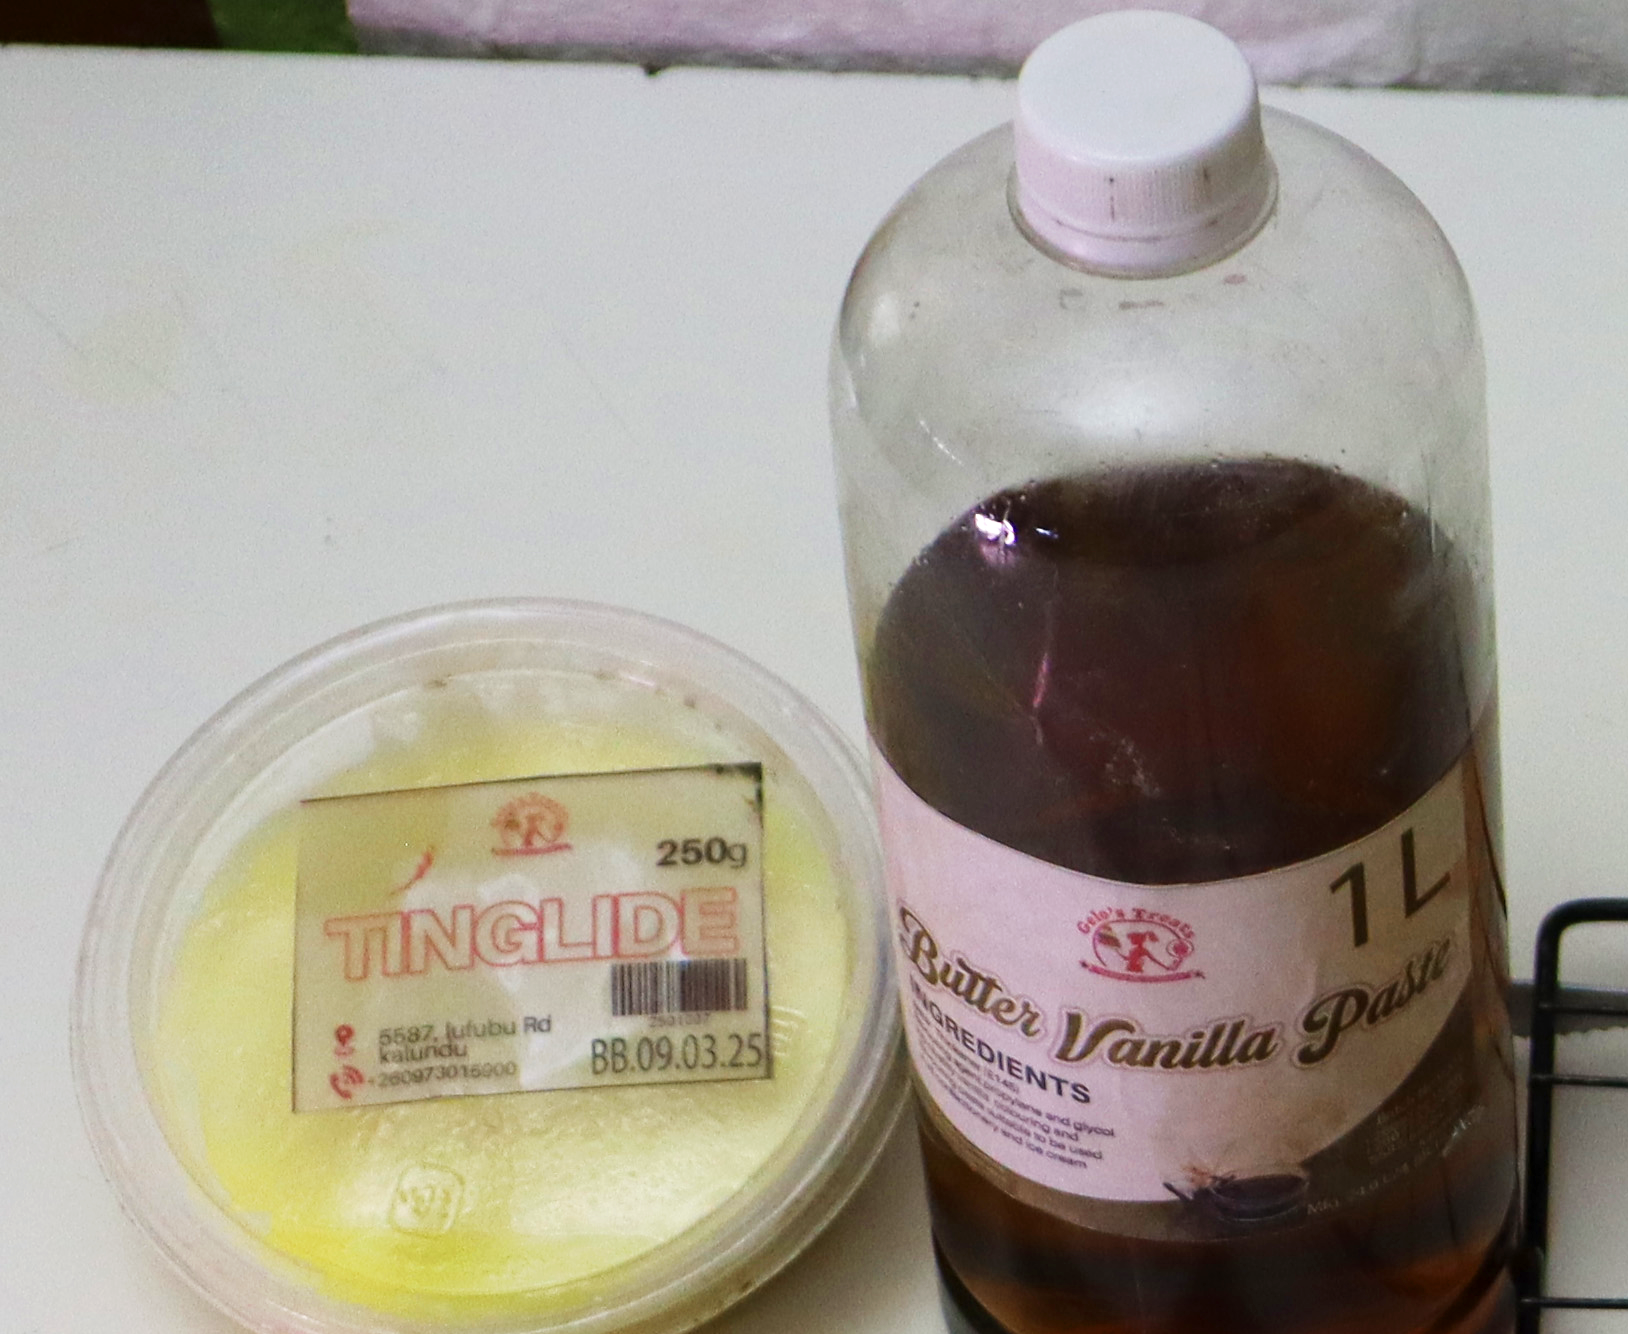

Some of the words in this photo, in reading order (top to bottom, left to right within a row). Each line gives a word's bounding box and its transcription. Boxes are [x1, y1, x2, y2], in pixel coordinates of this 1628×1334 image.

[655, 836, 749, 868] 250g
[1330, 861, 1368, 947] 1
[1401, 827, 1451, 918] L
[323, 887, 740, 983] TINGLIDE
[899, 906, 1041, 1037] Butter
[1056, 1013, 1279, 1069] Vanilla
[1298, 938, 1452, 1064] Paste
[523, 1014, 552, 1034] Rd
[910, 972, 1091, 1104] INGREDIENTS
[1046, 1112, 1070, 1127] and
[1001, 1128, 1023, 1145] and
[1033, 1131, 1046, 1143] to
[1049, 1136, 1066, 1150] be
[1054, 1128, 1079, 1142] and
